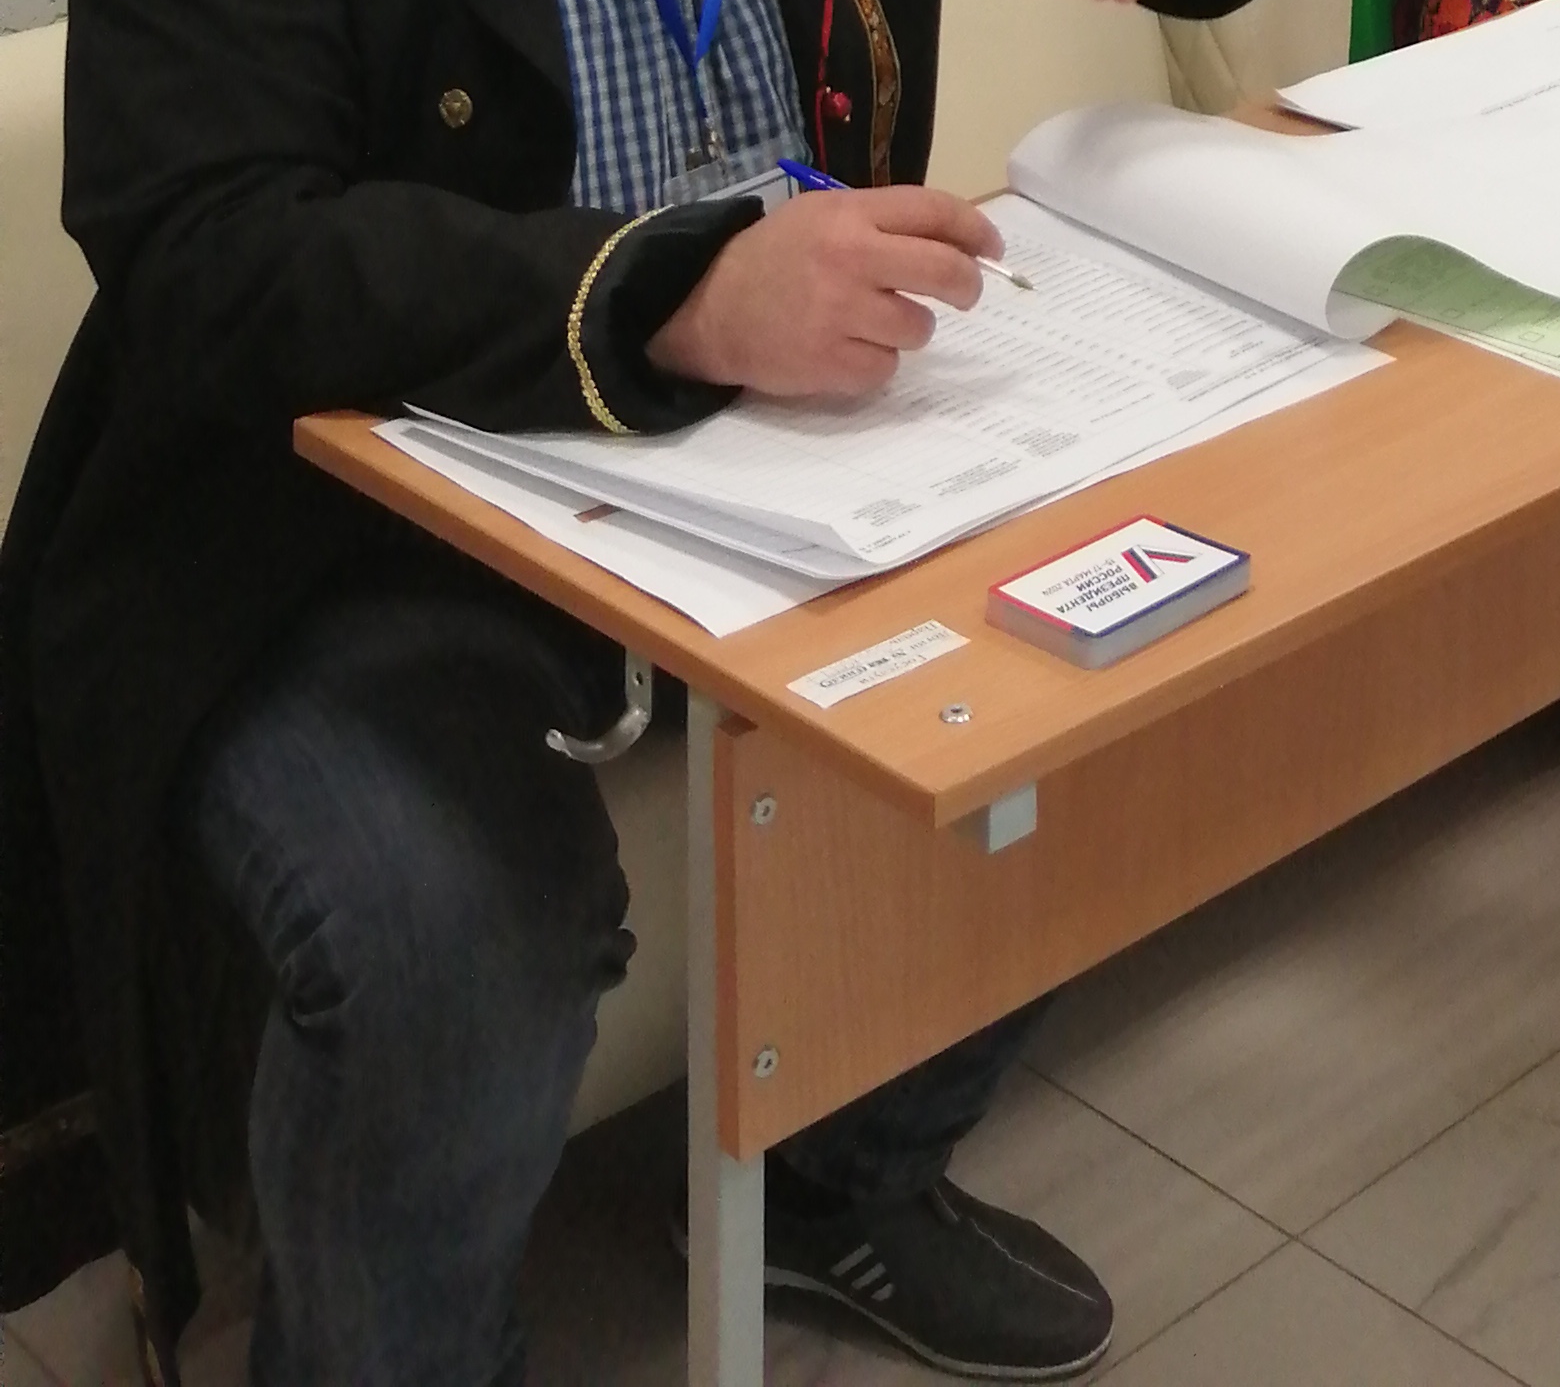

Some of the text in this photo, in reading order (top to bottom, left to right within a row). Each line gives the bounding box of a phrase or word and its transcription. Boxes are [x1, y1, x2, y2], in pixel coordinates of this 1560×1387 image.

[1056, 573, 1130, 614] ПРЕЗИДЕНТА
[1076, 565, 1123, 592] РОССИИ
[1086, 582, 1139, 612] ВЫБОРЫ
